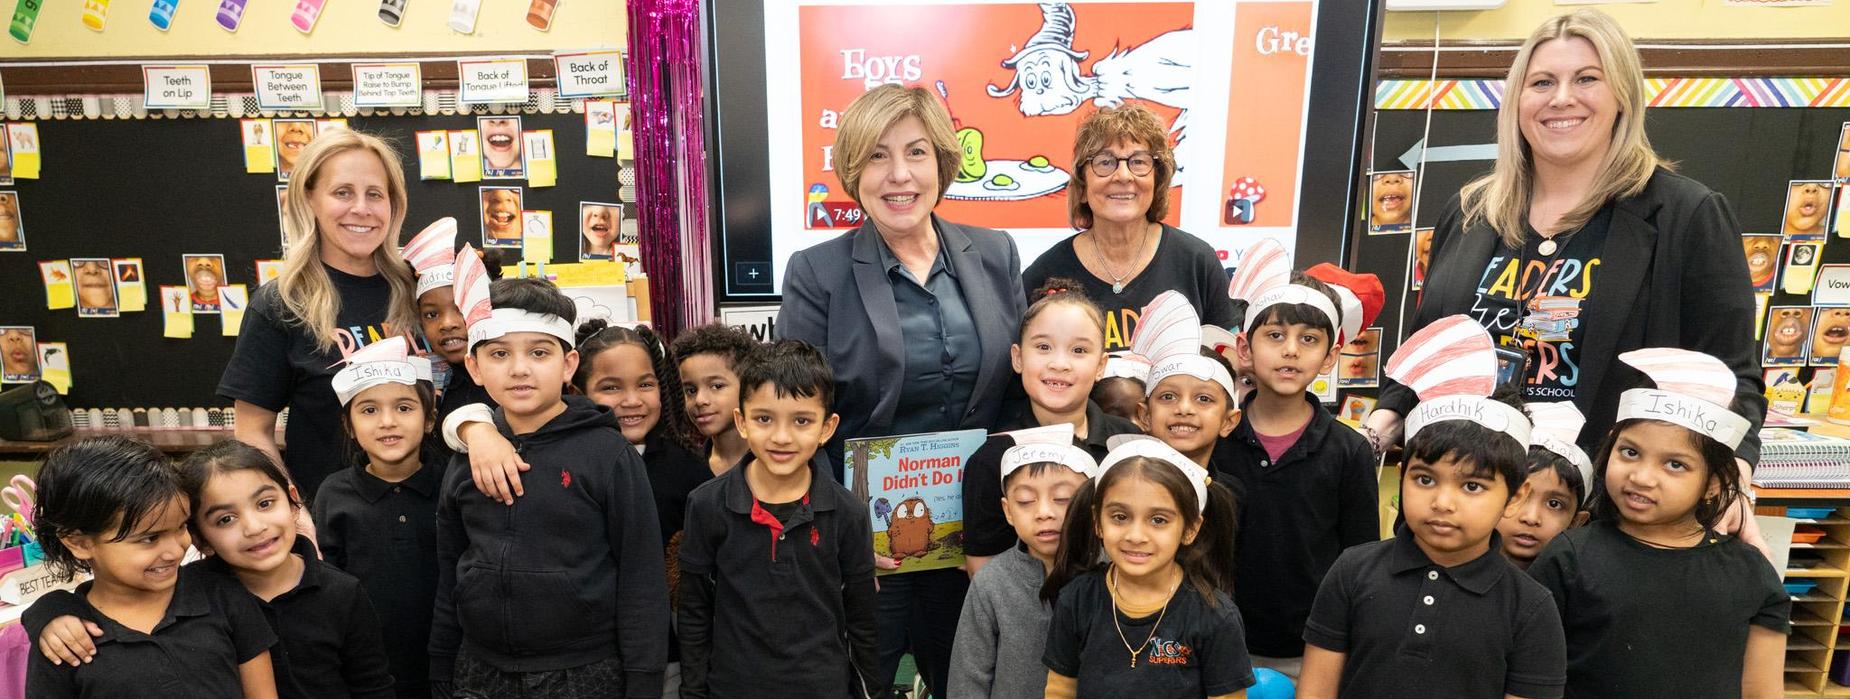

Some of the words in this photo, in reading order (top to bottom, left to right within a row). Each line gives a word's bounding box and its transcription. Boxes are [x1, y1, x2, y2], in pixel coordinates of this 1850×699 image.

[1256, 26, 1310, 56] Gre
[570, 61, 596, 73] Back
[598, 60, 608, 71] of
[163, 75, 192, 86] Teeth
[269, 70, 303, 82] Tongue
[363, 72, 375, 80] Tip
[385, 71, 410, 81] Tongue
[477, 70, 499, 80] Back
[500, 69, 509, 79] of
[574, 75, 608, 86] Throat
[267, 82, 308, 91] Between
[391, 81, 411, 90] Bump
[163, 90, 176, 98] on
[178, 89, 193, 99] Lip
[276, 93, 303, 103] Teeth
[384, 90, 397, 98] Top
[834, 208, 862, 222] 7:49
[1476, 256, 1600, 300] EADERS
[1828, 279, 1850, 289] Vow
[1152, 361, 1183, 380] Swar
[1536, 387, 1576, 397] SCHOOL
[1419, 399, 1485, 423] Hardhik
[1644, 394, 1717, 432] Ishika
[1013, 446, 1067, 465] Jeremy
[898, 455, 961, 472] Norman
[882, 473, 928, 491] Didn't
[932, 471, 953, 486] Do
[20, 578, 39, 595] BEST
